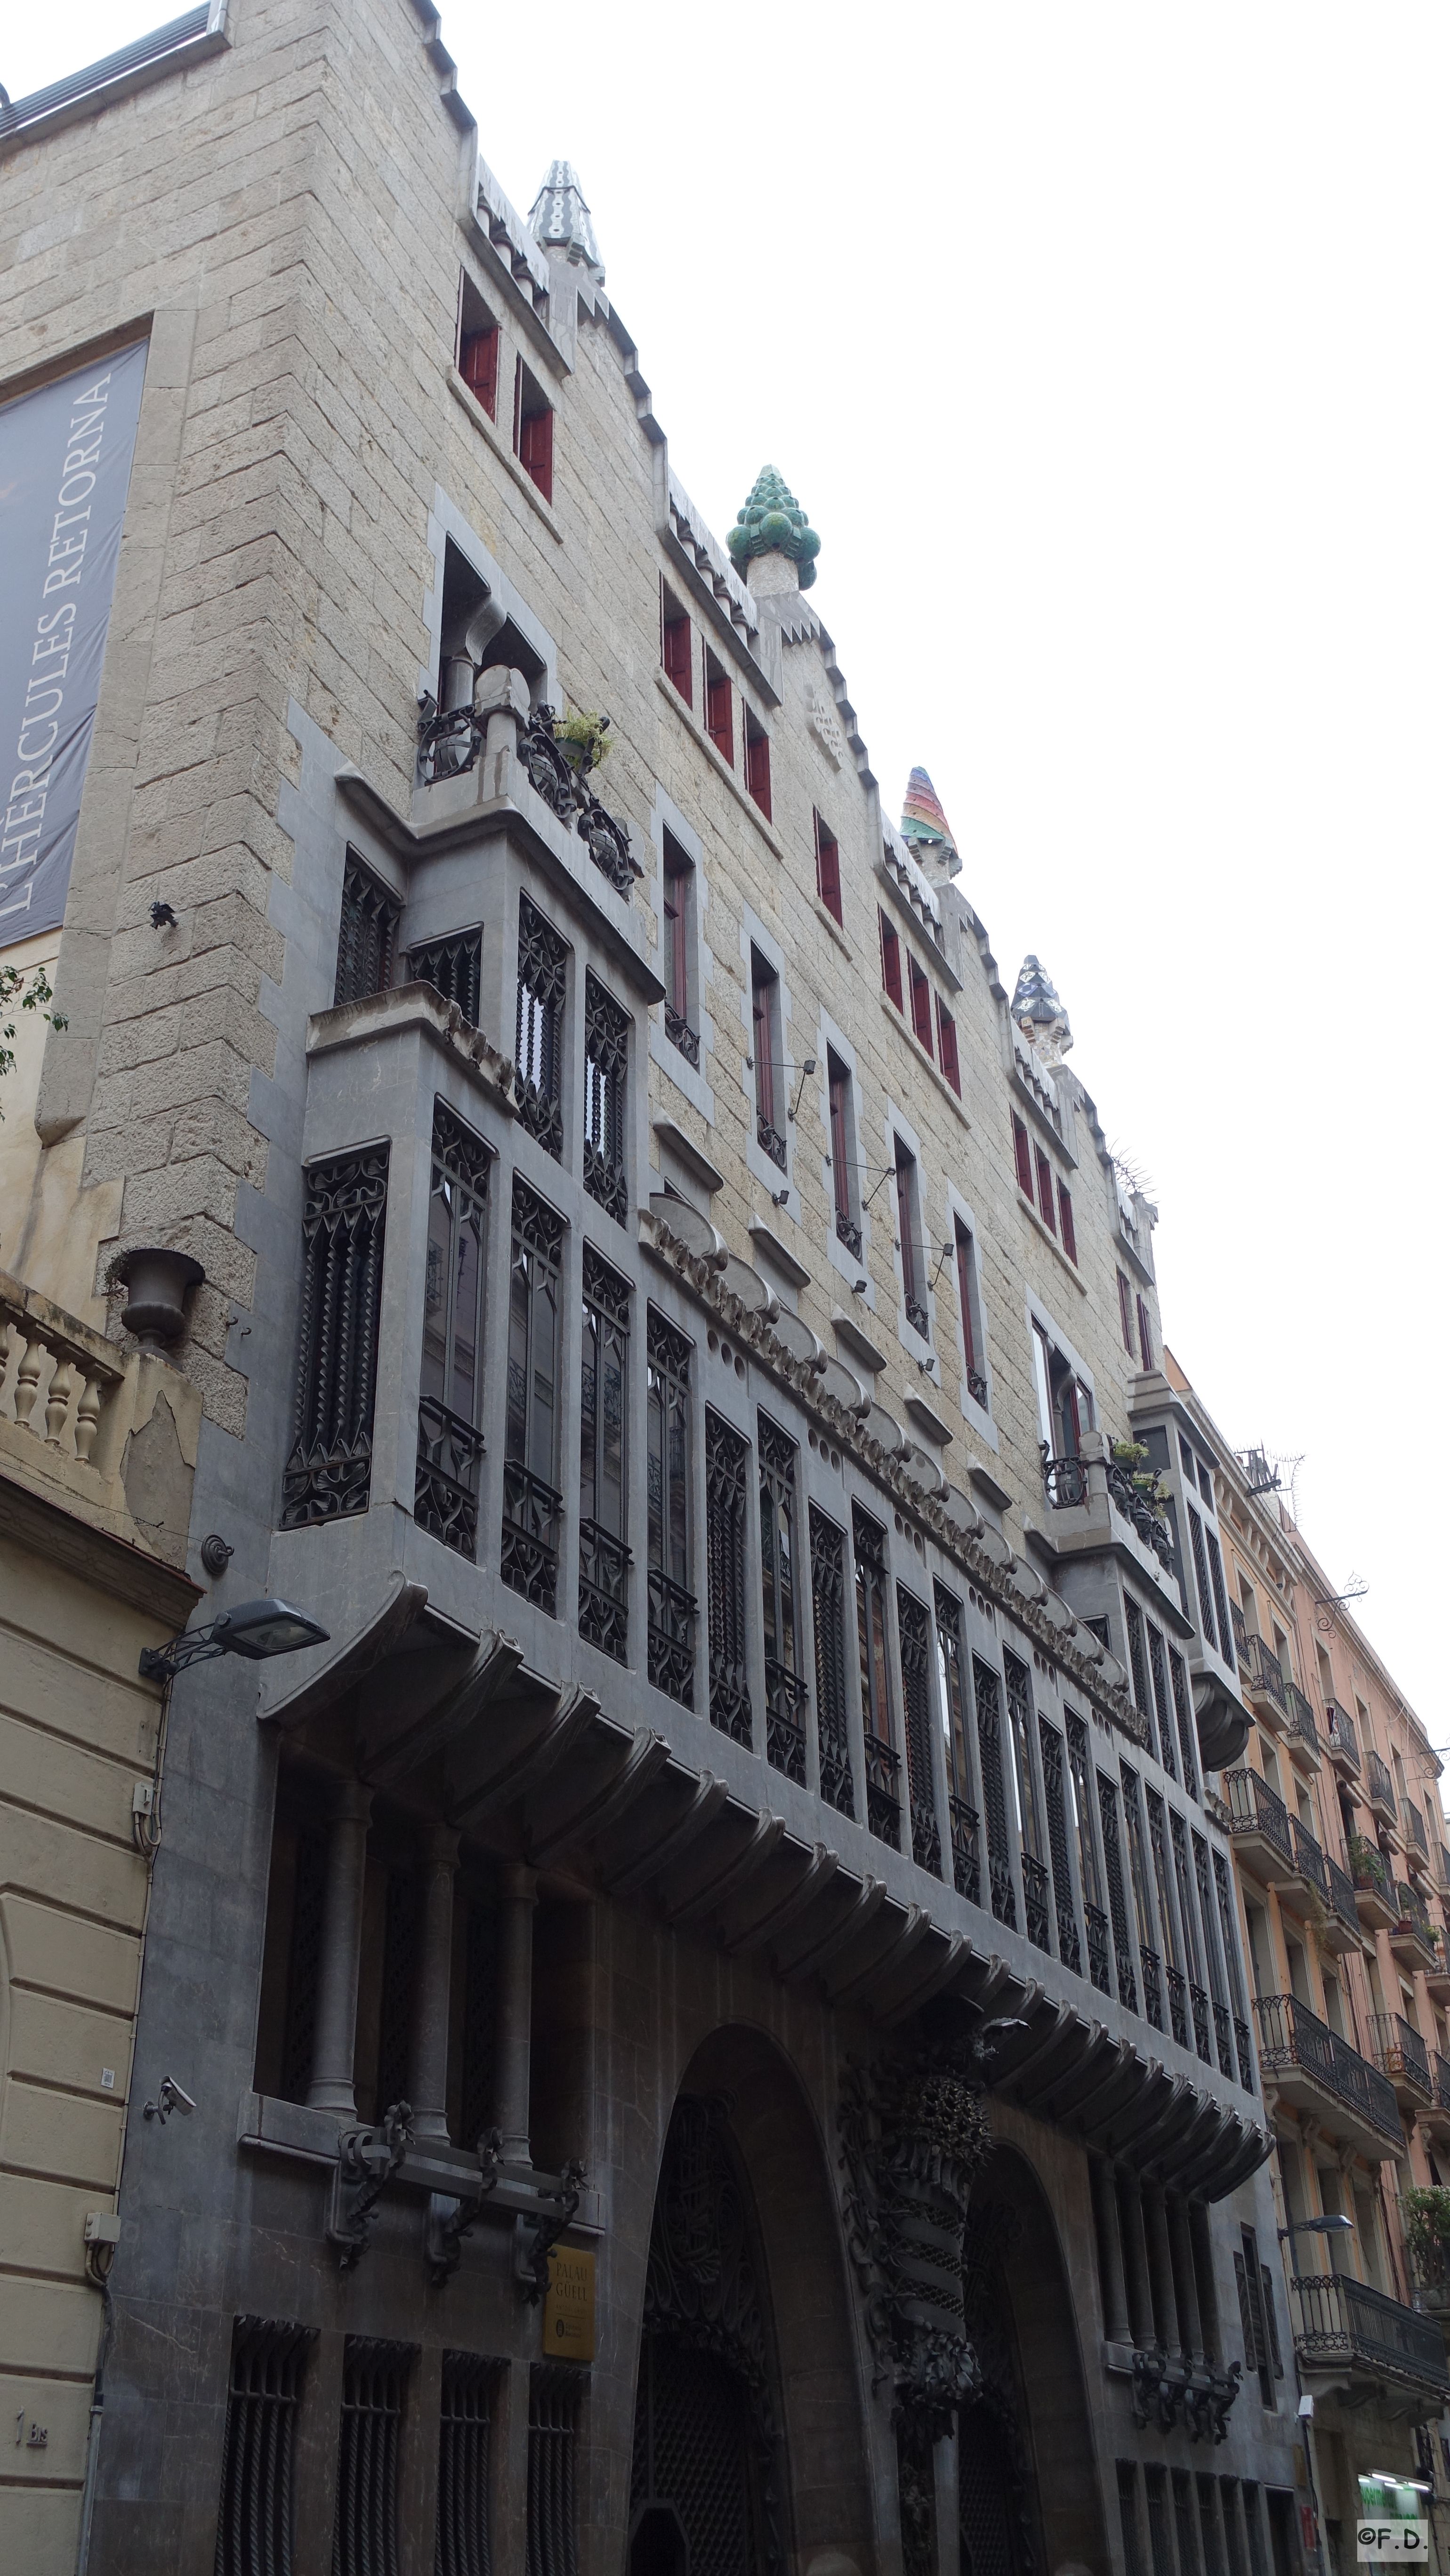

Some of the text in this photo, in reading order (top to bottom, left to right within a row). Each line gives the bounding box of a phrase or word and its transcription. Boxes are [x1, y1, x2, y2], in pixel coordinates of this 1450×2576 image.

[42, 372, 111, 599] RETORNA
[556, 2262, 588, 2282] PALAU
[556, 2280, 588, 2302] GÜELL
[16, 2406, 24, 2446] 1
